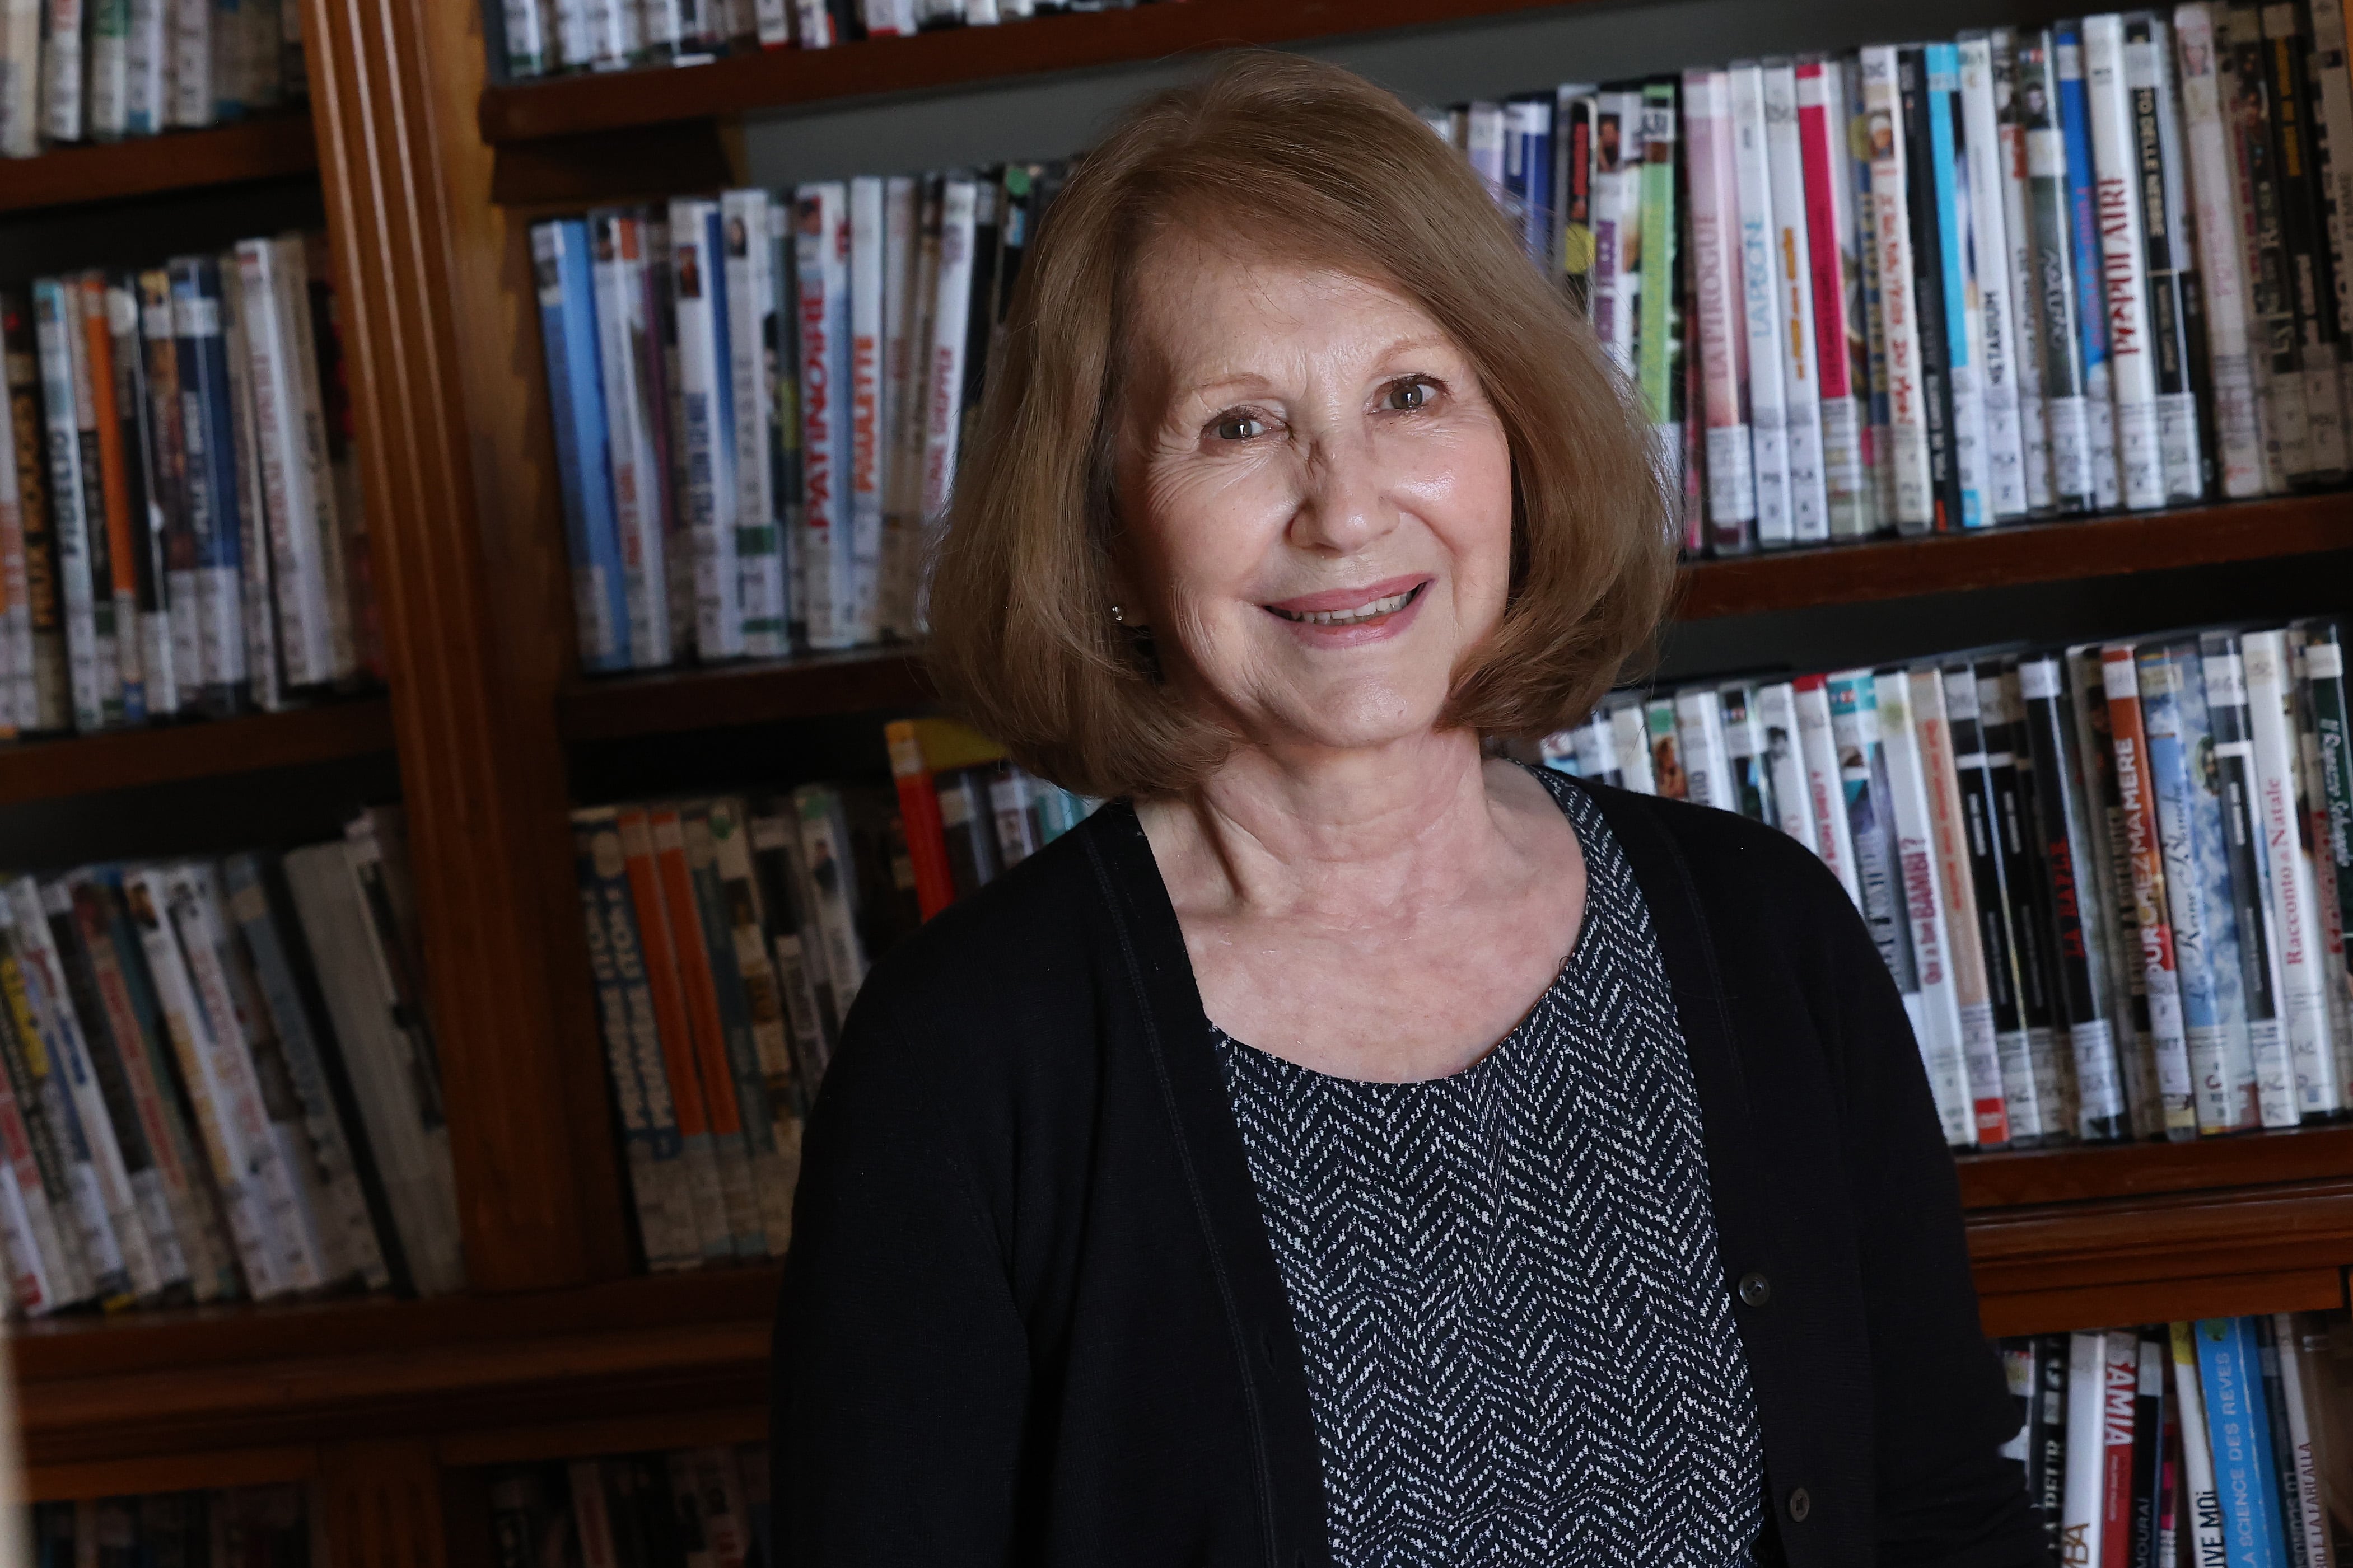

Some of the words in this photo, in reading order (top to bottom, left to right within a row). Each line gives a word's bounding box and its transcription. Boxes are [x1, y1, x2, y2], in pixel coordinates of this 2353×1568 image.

[1692, 216, 1725, 344] PIROGUE
[2097, 179, 2140, 354] POPULAIRE
[2113, 737, 2142, 812] MERE
[2126, 813, 2150, 854] MA
[2266, 778, 2287, 847] Natale
[1903, 851, 1936, 919] BAMBI
[2130, 855, 2159, 925] CHEZ
[2280, 867, 2303, 965] Racconto
[2104, 1352, 2137, 1447] SAMIA
[2224, 1422, 2243, 1461] DES
[2229, 1467, 2255, 1548] SCIENCE
